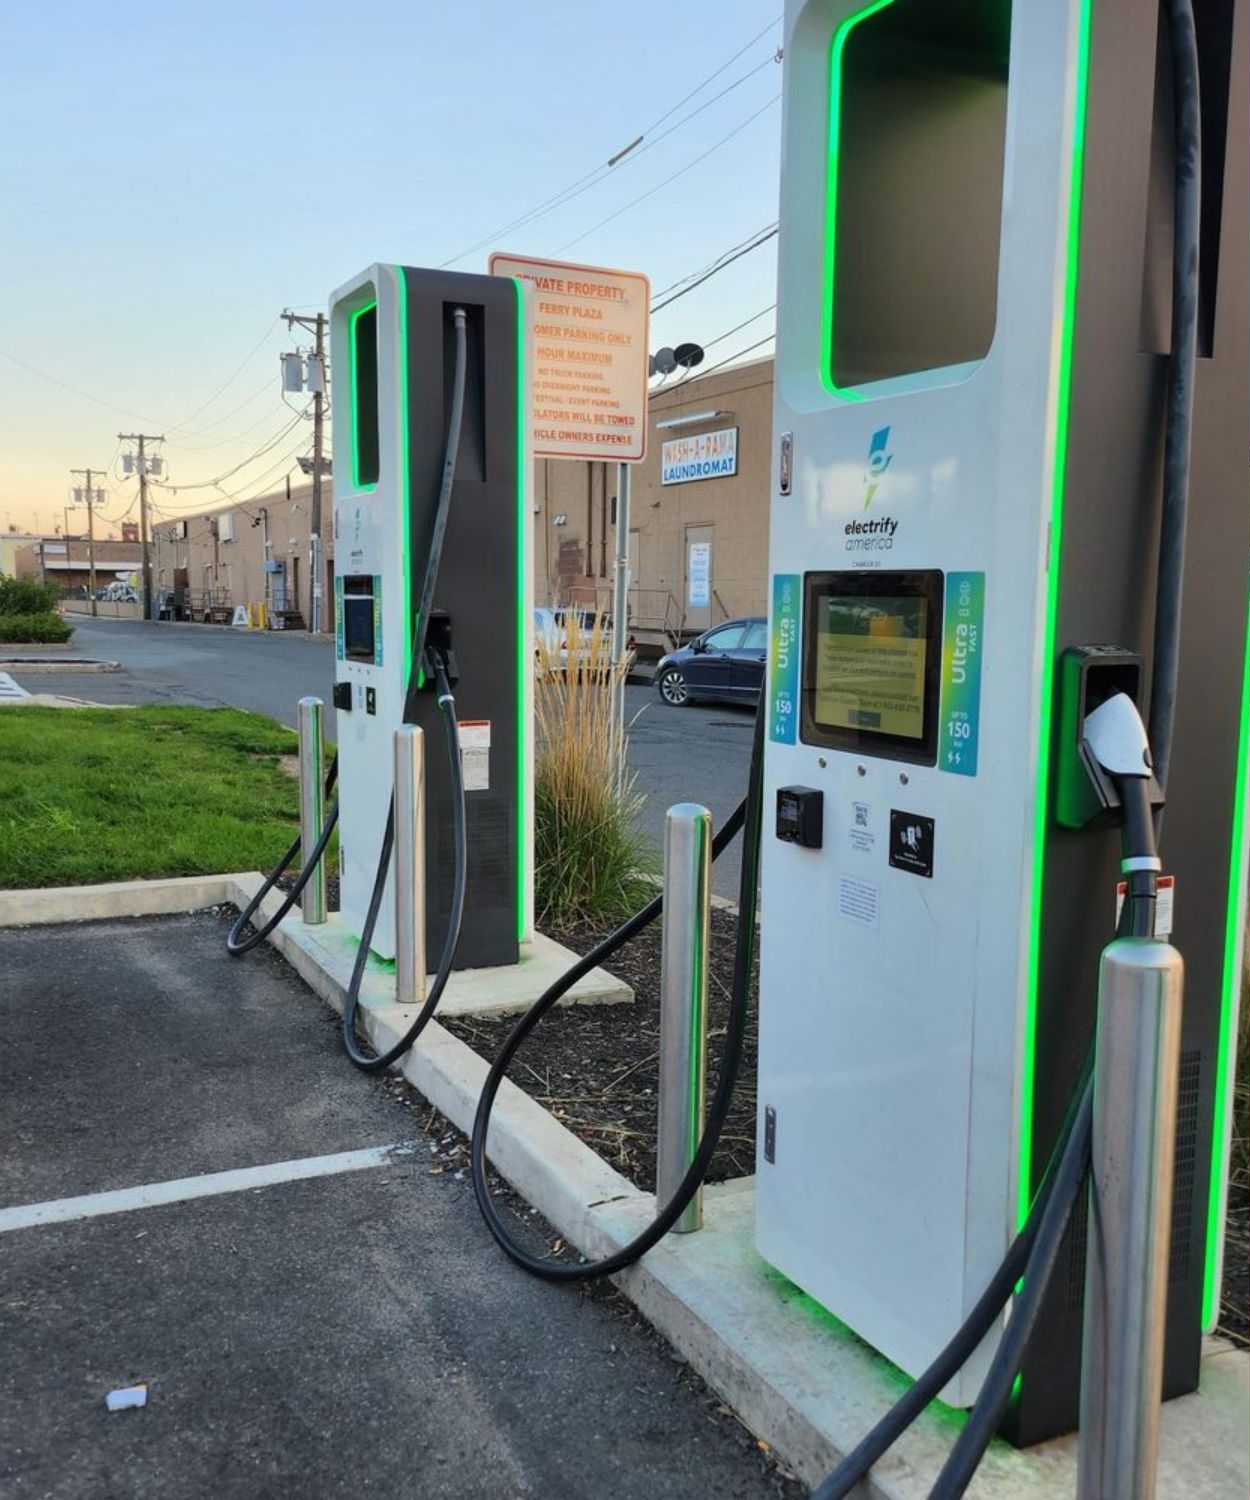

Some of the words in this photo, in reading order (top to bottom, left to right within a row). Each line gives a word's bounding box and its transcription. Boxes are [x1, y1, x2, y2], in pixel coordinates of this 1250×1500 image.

[567, 281, 626, 300] PROPERTY
[539, 302, 570, 316] FERRY
[572, 306, 603, 320] PLAZA
[534, 324, 561, 337] OMER
[563, 327, 605, 342] PARKING
[608, 332, 632, 345] ONLY
[537, 347, 565, 360] HOUR
[567, 349, 613, 363] MAXIMUM
[574, 371, 603, 381] PARKING
[542, 381, 580, 392] OVERNIGHT
[582, 385, 611, 395] PARKING
[534, 394, 563, 404] ESTIVAL
[569, 397, 590, 406] EVENT
[591, 398, 620, 408] PARKING
[533, 408, 570, 420] LATORS
[571, 411, 592, 423] WILL
[593, 413, 605, 424] BE
[607, 414, 635, 426] TOWED
[533, 428, 556, 440] ICLE
[558, 430, 594, 442] OWNERS
[595, 432, 633, 445] EXPENSE
[664, 457, 734, 481] LAUNDROMAT
[845, 517, 898, 536] electrify
[845, 537, 893, 551] america
[777, 618, 790, 669] Ultra
[968, 623, 977, 653] FAST
[951, 623, 968, 684] Ultra
[776, 700, 792, 715] 150
[947, 721, 970, 739] 150
